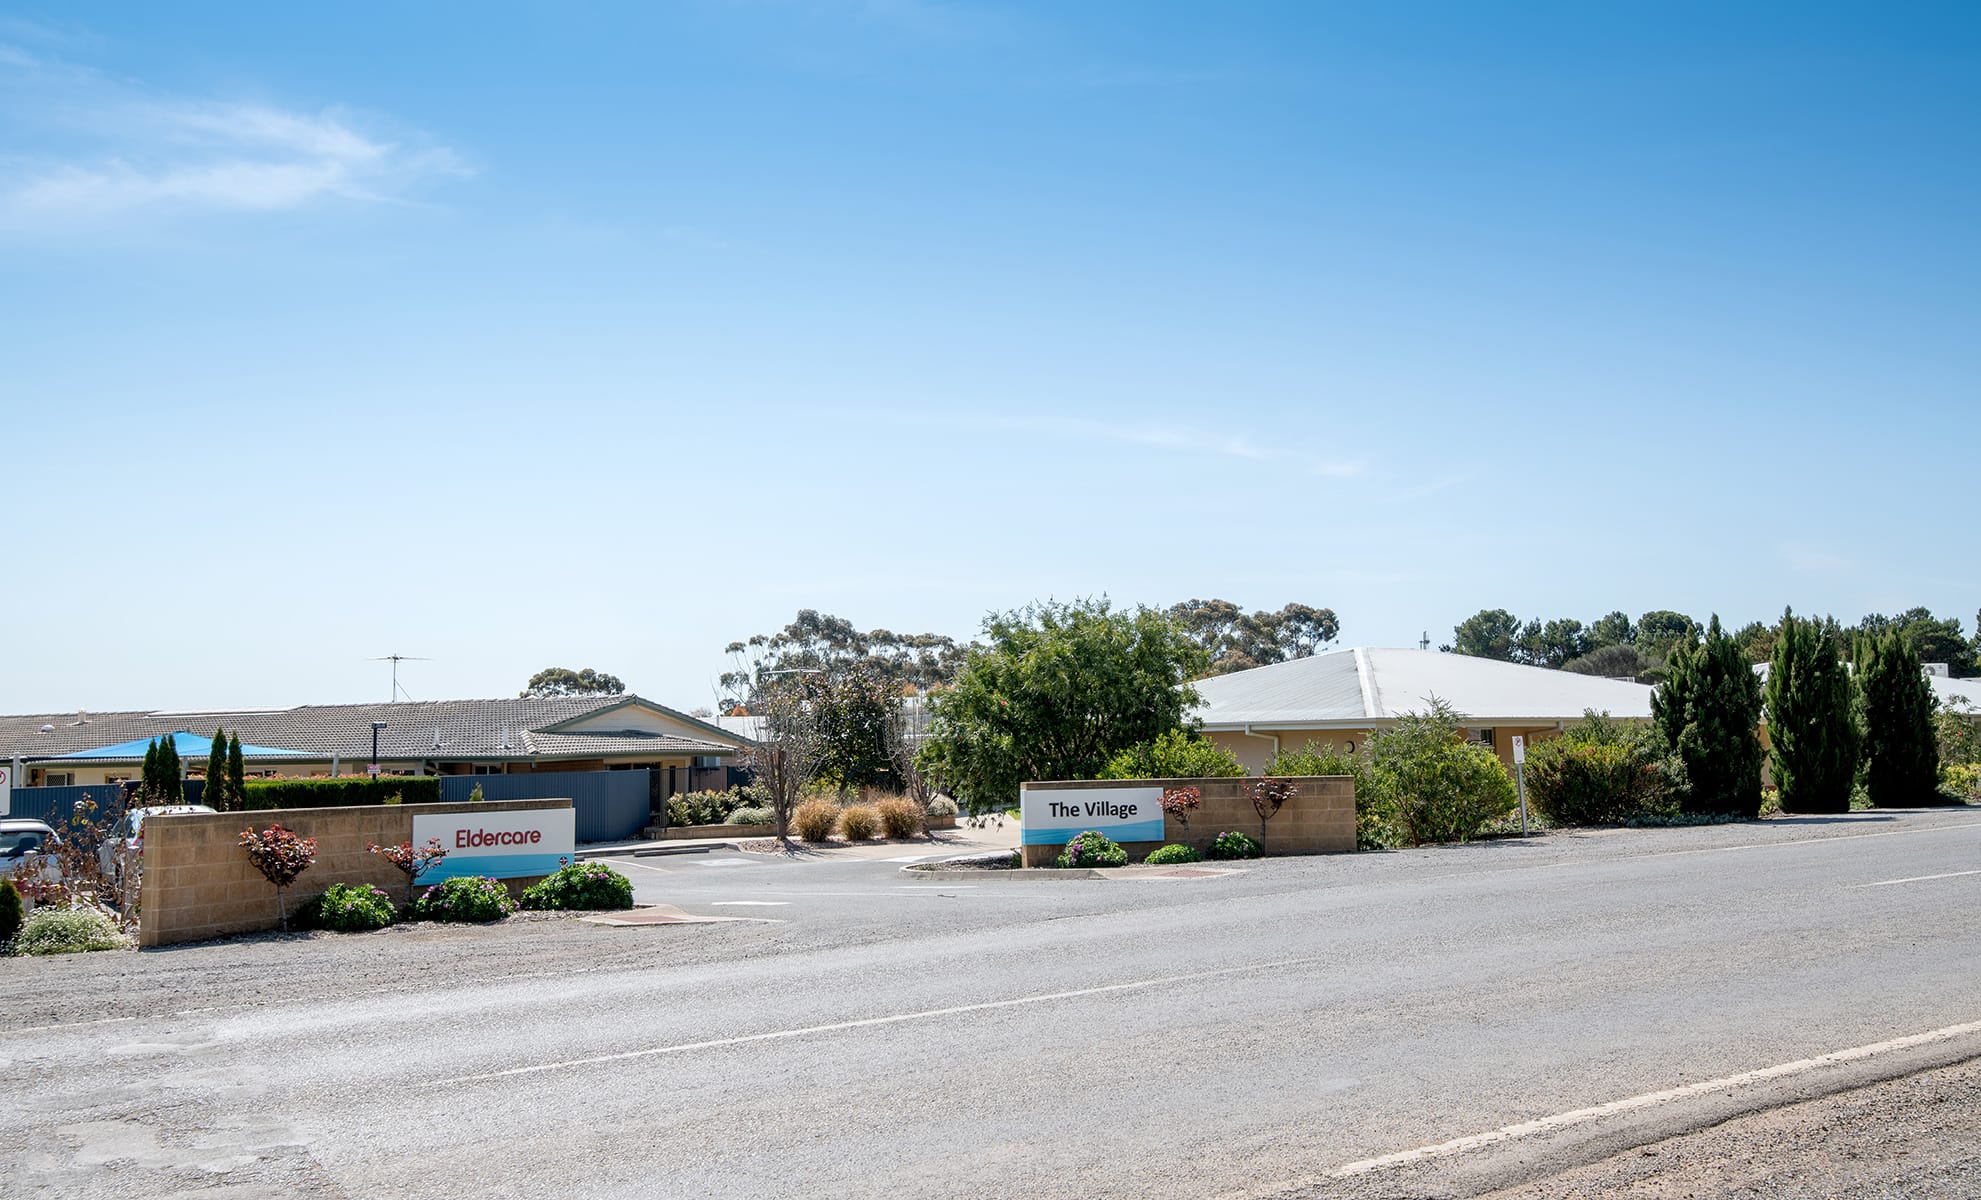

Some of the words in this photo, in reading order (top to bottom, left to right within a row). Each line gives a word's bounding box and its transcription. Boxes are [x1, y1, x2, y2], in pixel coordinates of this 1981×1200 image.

[1048, 801, 1080, 818] The
[1084, 800, 1138, 820] Village
[455, 827, 542, 849] Eldercare
